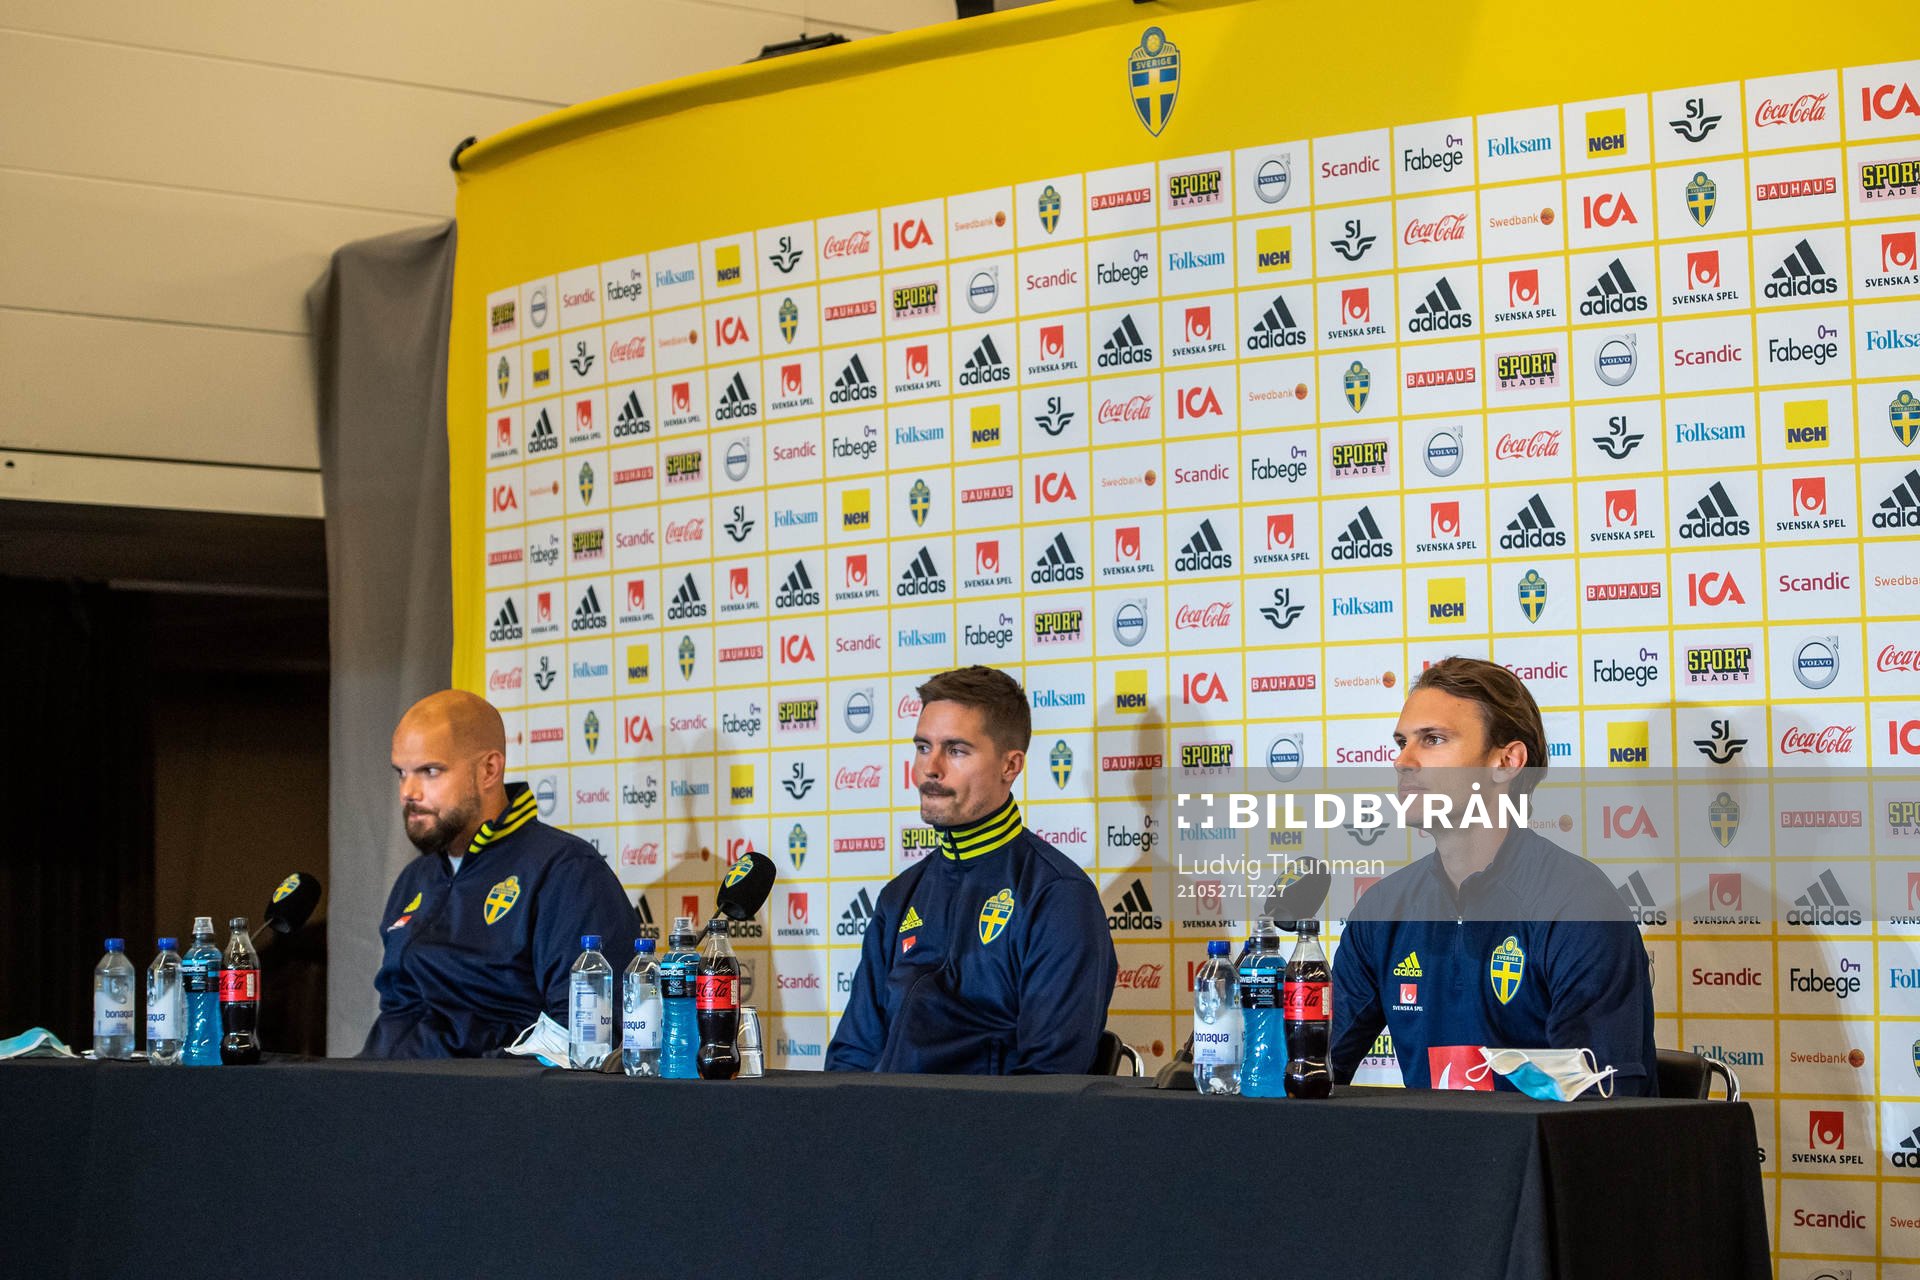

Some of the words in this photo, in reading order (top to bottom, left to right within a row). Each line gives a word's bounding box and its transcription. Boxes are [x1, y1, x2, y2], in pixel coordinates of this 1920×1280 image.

[1136, 57, 1173, 69] SVERIGE
[1686, 98, 1704, 118] SJ
[1862, 82, 1920, 122] ICA
[1488, 137, 1551, 157] Folksam
[1322, 155, 1380, 178] Scandic
[1404, 147, 1463, 172] Fabege
[1171, 168, 1220, 196] SPORT
[1759, 180, 1834, 198] BAUHAUS
[1094, 191, 1148, 208] BAUHAUS
[1490, 214, 1538, 228] Swedbank
[779, 236, 791, 252] SJ
[893, 218, 934, 252] ICA
[1764, 276, 1838, 298] adidas
[1865, 275, 1911, 288] SVENSKA
[894, 283, 937, 310] SPORT
[1408, 312, 1472, 333] adidas
[1495, 311, 1533, 322] SVENSKA
[1536, 308, 1557, 318] SPEL
[1866, 328, 1920, 351] Folksa
[1097, 348, 1152, 367] adidas
[1172, 346, 1206, 357] SVENSKA
[1208, 344, 1226, 352] SPEL
[1601, 353, 1629, 366] VOLVO
[1674, 344, 1742, 366] Scandic
[1769, 338, 1837, 365] Fabege
[1500, 352, 1555, 380] SPORT
[1409, 370, 1473, 385] BAUHAUS
[1502, 376, 1553, 389] BLADET
[715, 403, 757, 421] adidas
[1047, 396, 1061, 414] SJ
[896, 426, 944, 445] Folksam
[1334, 441, 1386, 467] SPORT
[1429, 446, 1456, 457] VOLVO
[1175, 464, 1229, 484] Scandic
[1252, 457, 1307, 483] Fabege
[1335, 463, 1385, 475] BLADET
[963, 487, 1011, 502] BAUHAUS
[1035, 472, 1077, 504] ICA
[1777, 520, 1820, 531] SVENSKA
[1823, 519, 1846, 528] SPEL
[1872, 508, 1920, 528] adid
[1679, 519, 1750, 539] adidas
[1331, 541, 1393, 560] adidas
[1416, 542, 1454, 552] SVENSKA
[1457, 541, 1477, 550] SPEL
[1175, 554, 1232, 572] adidas
[1254, 554, 1289, 564] SVENSKA
[1291, 552, 1310, 561] SPEL
[1031, 565, 1084, 584] adidas
[1103, 566, 1136, 576] SVENSKA
[1137, 564, 1154, 573] SPEL
[897, 579, 946, 597] adidas
[964, 578, 995, 588] SVENSKA
[996, 576, 1012, 585] SPEL
[1688, 571, 1745, 607] ICA
[1780, 572, 1850, 592] Scandic
[1874, 575, 1920, 587] Swedba
[1274, 588, 1289, 606] SJ
[1589, 585, 1658, 598] BAUHAUS
[1332, 597, 1393, 616] Folksam
[1035, 610, 1081, 634] SPORT
[898, 629, 946, 647] Folksam
[965, 624, 1013, 649] Fabege
[1689, 647, 1749, 673] SPORT
[1800, 657, 1832, 669] VOLVO
[1335, 676, 1380, 687] Swedbank
[1594, 659, 1658, 687] Fabege
[1691, 669, 1747, 681] BLADET
[1183, 672, 1228, 704] ICA
[1254, 677, 1313, 690] BAUHAUS
[1033, 689, 1086, 708] Folksam
[779, 699, 818, 722] SPORT
[1711, 720, 1729, 739] SJ
[1103, 756, 1162, 770] BAUHAUS
[1181, 744, 1232, 767] SPORT
[1272, 753, 1299, 762] VOLVO
[1336, 746, 1396, 764] Scandic
[1604, 806, 1658, 838] ICA
[1782, 811, 1861, 827] BAUHAUS
[836, 839, 883, 851] BAUHAUS
[1107, 825, 1159, 852] Fabege
[1182, 920, 1217, 928] SVENSKA
[1219, 919, 1237, 927] SPEL
[1694, 915, 1736, 925] SVENSKA
[1738, 915, 1761, 926] SPEL
[1786, 905, 1862, 926] adidas
[1393, 967, 1423, 977] adidas
[1692, 968, 1762, 986] Scandic
[1790, 968, 1861, 999] Fabege
[776, 1039, 821, 1056] Folksam
[1362, 1058, 1396, 1066] ADET
[1790, 1052, 1847, 1064] Swedbank
[1792, 1152, 1836, 1163] SVENSKA
[1839, 1152, 1863, 1164] SPEL
[1794, 1209, 1866, 1229] Scandic
